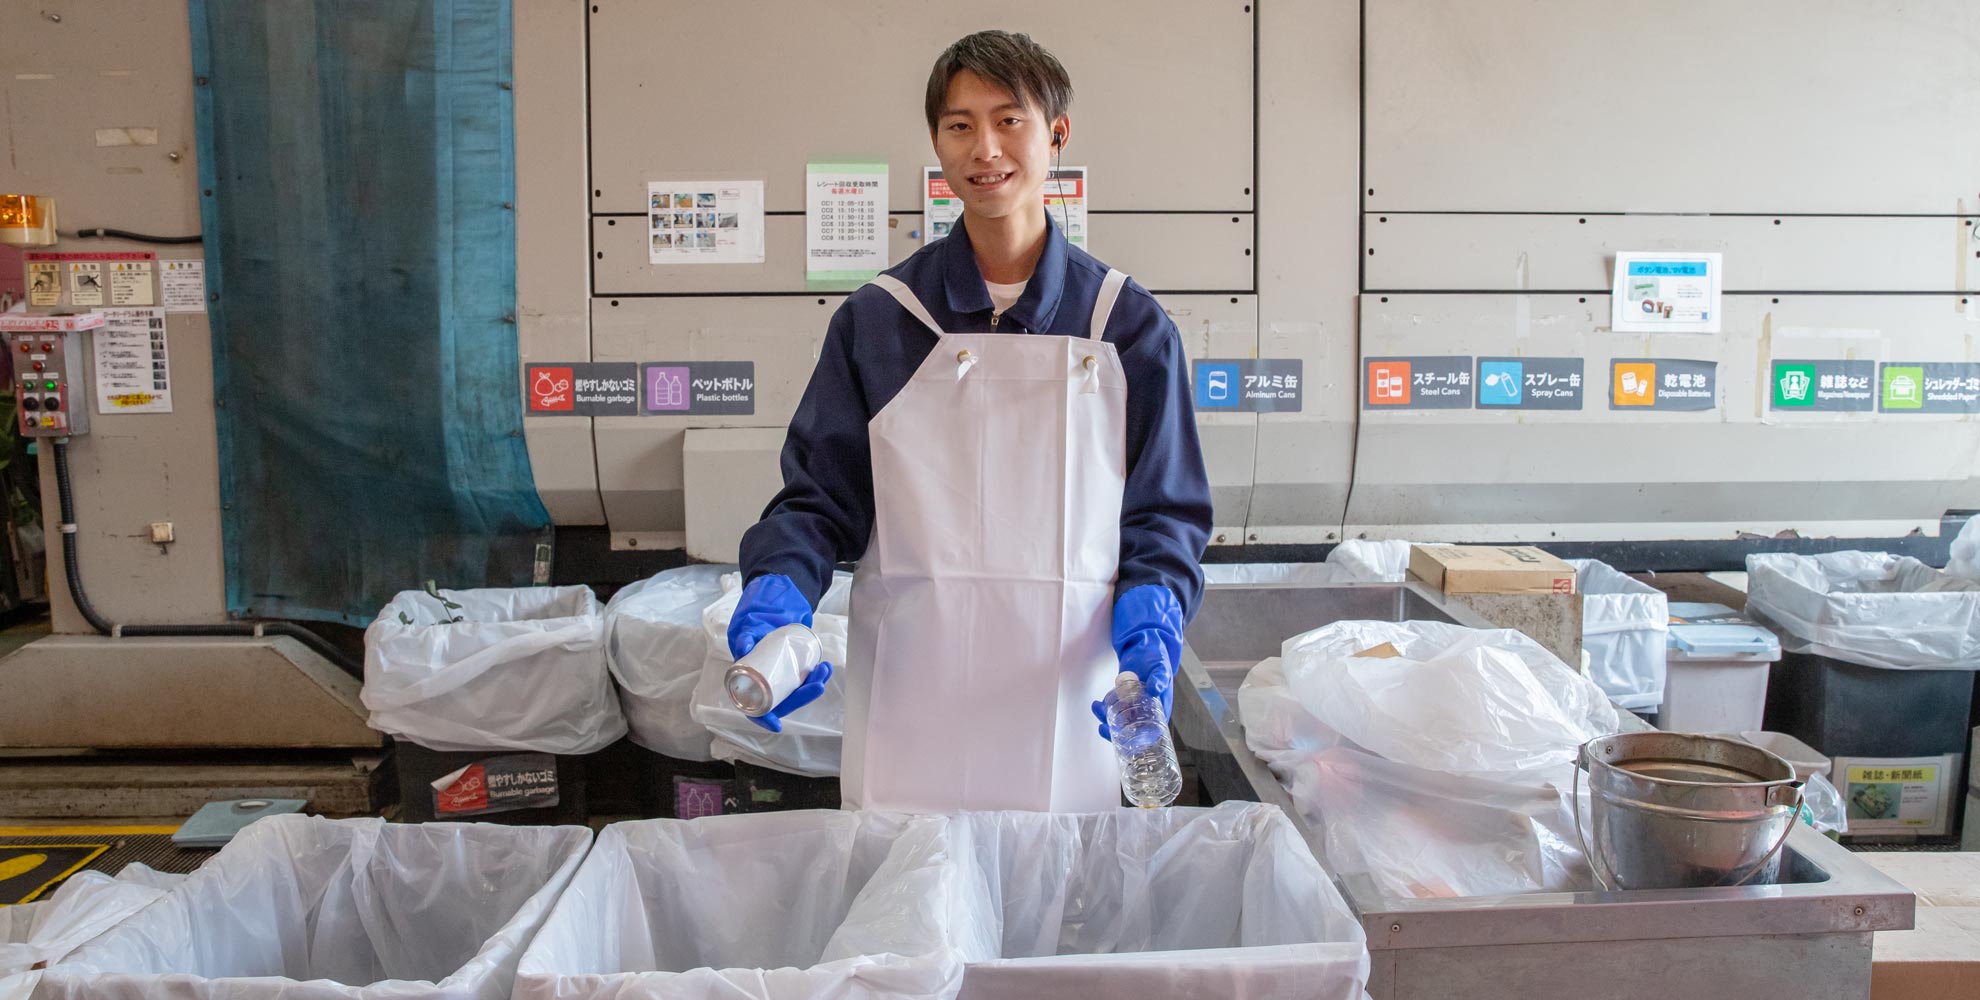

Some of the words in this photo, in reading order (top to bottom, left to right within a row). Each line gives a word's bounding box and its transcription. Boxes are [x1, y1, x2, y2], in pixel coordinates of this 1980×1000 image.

[692, 377, 753, 391] ペットボトル
[1244, 374, 1298, 389] アルミ缶
[1413, 371, 1470, 386] スチール缶
[1525, 372, 1581, 387] スプレー缶
[1664, 373, 1706, 388] 乾電池
[1819, 374, 1869, 389] 雑誌など
[1924, 376, 1980, 391] シュレッダーゴミ
[575, 378, 636, 392] 燃やすしかないゴミ
[696, 393, 721, 401] Plastic
[722, 393, 749, 401] bottles
[1278, 390, 1296, 399] Cans
[1420, 387, 1440, 396] Steel
[1441, 387, 1461, 396] Cans
[1531, 388, 1553, 399] Spray
[1554, 388, 1574, 397] Cans
[1658, 389, 1687, 399] Disposable
[1687, 389, 1711, 398] Batteries
[1927, 392, 1958, 401] Shredded
[1958, 393, 1977, 402] Paper
[576, 394, 606, 402] Burnable
[606, 394, 635, 404] garbage
[1861, 769, 1924, 781] 雑誌・新聞紙
[489, 787, 523, 798] Burnable
[524, 786, 555, 797] garbage
